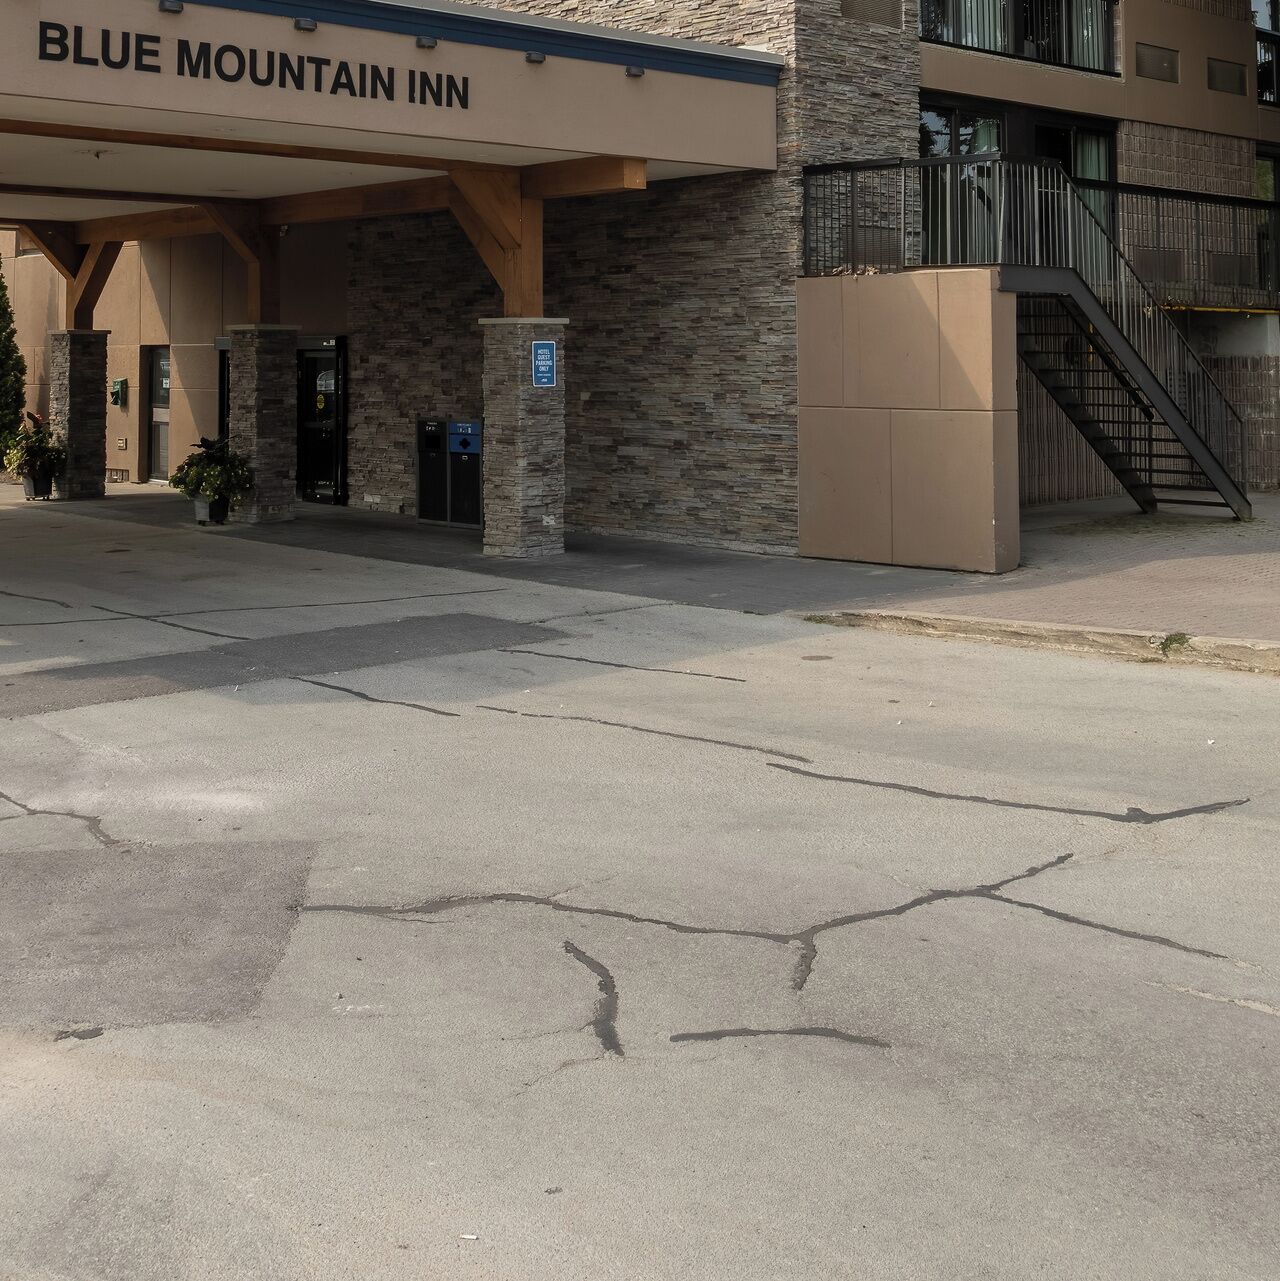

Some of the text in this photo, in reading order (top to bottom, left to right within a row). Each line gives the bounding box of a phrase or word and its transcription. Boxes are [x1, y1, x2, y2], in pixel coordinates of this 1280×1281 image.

[38, 21, 469, 109] BLUE MOUNTAIN INN
